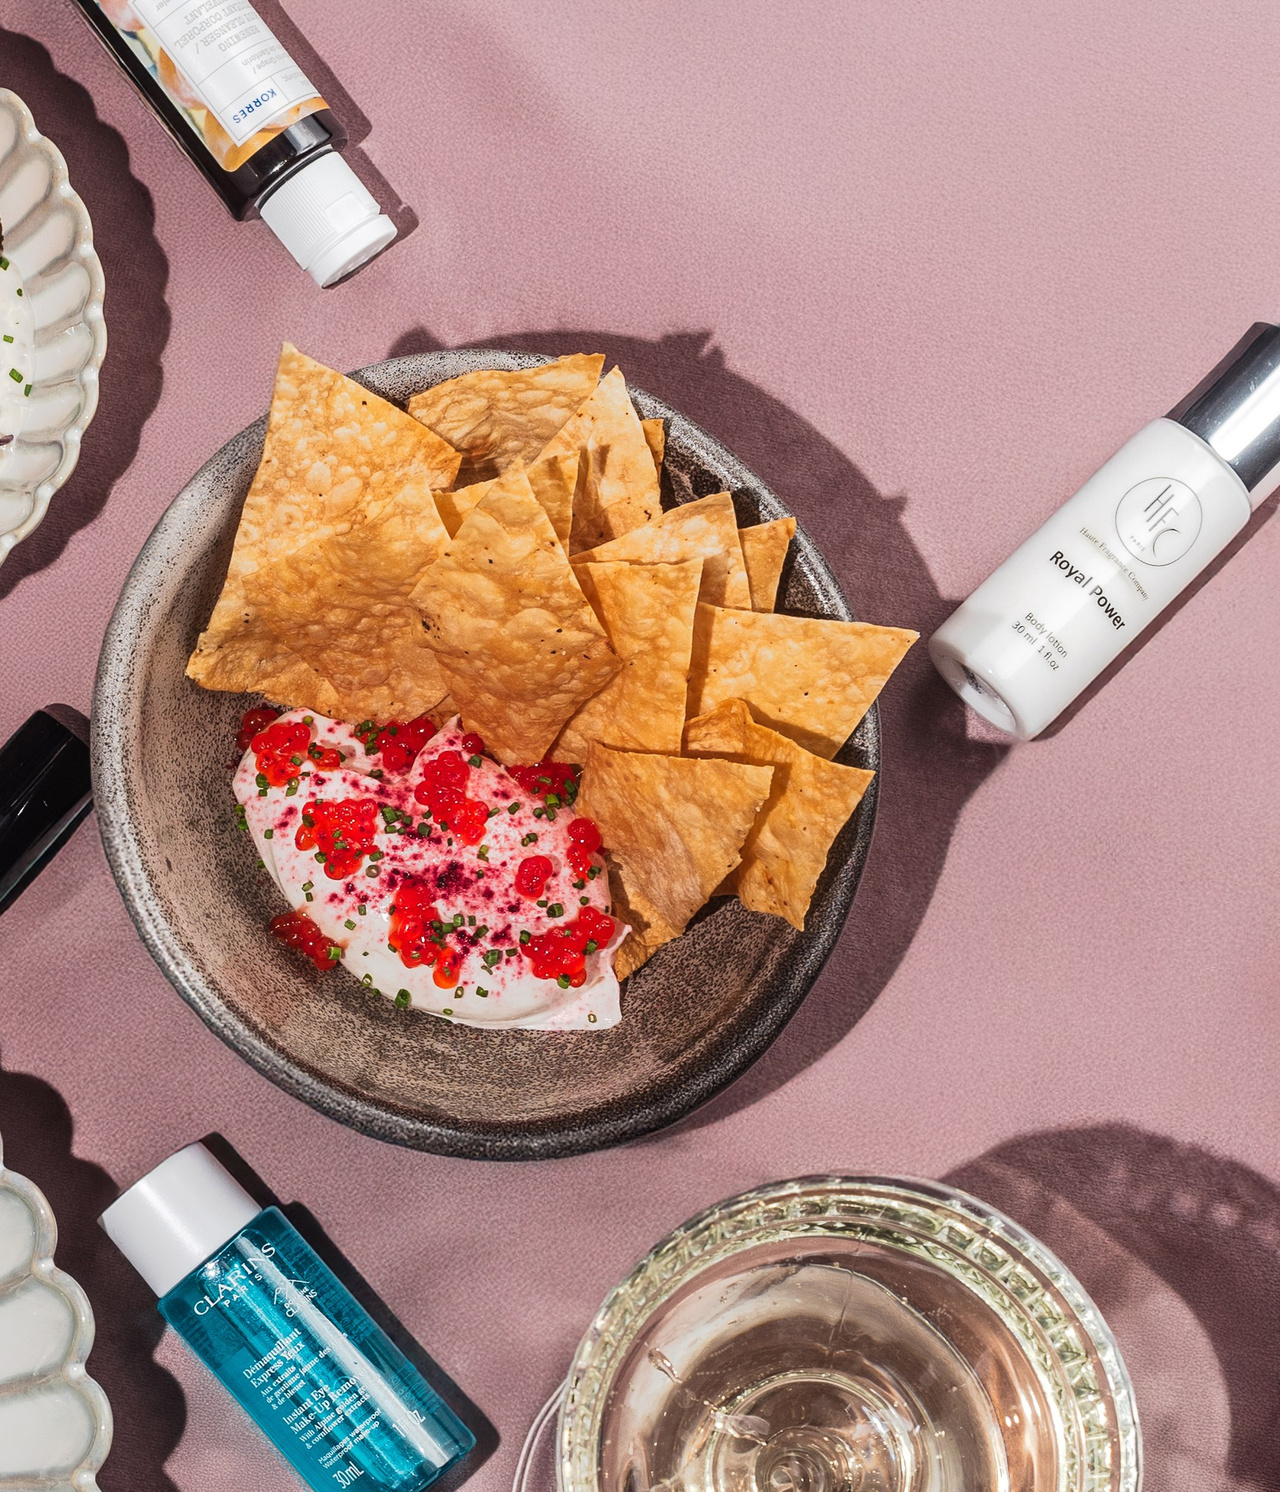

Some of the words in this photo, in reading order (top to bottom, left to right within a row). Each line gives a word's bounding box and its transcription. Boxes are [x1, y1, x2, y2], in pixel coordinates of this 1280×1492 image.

[174, 11, 222, 49] CORPOREL
[200, 15, 246, 47] CLEANSER
[218, 24, 259, 52] RENEWING
[232, 88, 276, 123] KORRES
[1079, 527, 1100, 544] Haute
[1099, 542, 1130, 573] Fragrance
[1128, 571, 1149, 601] Company
[1049, 550, 1093, 588] Royal
[1088, 585, 1126, 630] Power
[1012, 620, 1026, 637] 30
[1023, 632, 1038, 645] ml
[1036, 644, 1045, 653] 1
[1025, 612, 1047, 634] Body
[1046, 631, 1068, 658] lotion
[194, 1243, 275, 1315] CLARINS
[224, 1273, 263, 1308] PARIS
[242, 1327, 302, 1379] Démaquillant
[251, 1358, 284, 1388] Express
[281, 1341, 306, 1361] Yeux
[265, 1394, 274, 1404] de
[274, 1372, 300, 1399] gentiane
[299, 1357, 320, 1376] jaune
[318, 1346, 331, 1359] des
[261, 1386, 273, 1397] Aux
[272, 1365, 296, 1387] extraits
[270, 1402, 278, 1410] &
[277, 1396, 286, 1405] de
[284, 1379, 306, 1399] bleuet
[283, 1398, 313, 1425] Instant
[311, 1384, 331, 1401] Eye
[291, 1399, 330, 1434] Make-Up
[328, 1368, 367, 1403] Remov
[299, 1428, 315, 1443] With
[314, 1412, 336, 1431] Alpine
[335, 1391, 358, 1415] golden
[305, 1441, 312, 1450] &
[311, 1415, 345, 1444] cornflower
[344, 1393, 370, 1416] extracts
[318, 1436, 350, 1464] Maquillages
[350, 1407, 382, 1438] waterproof
[323, 1441, 354, 1470] Waterproof
[354, 1421, 380, 1445] make-up
